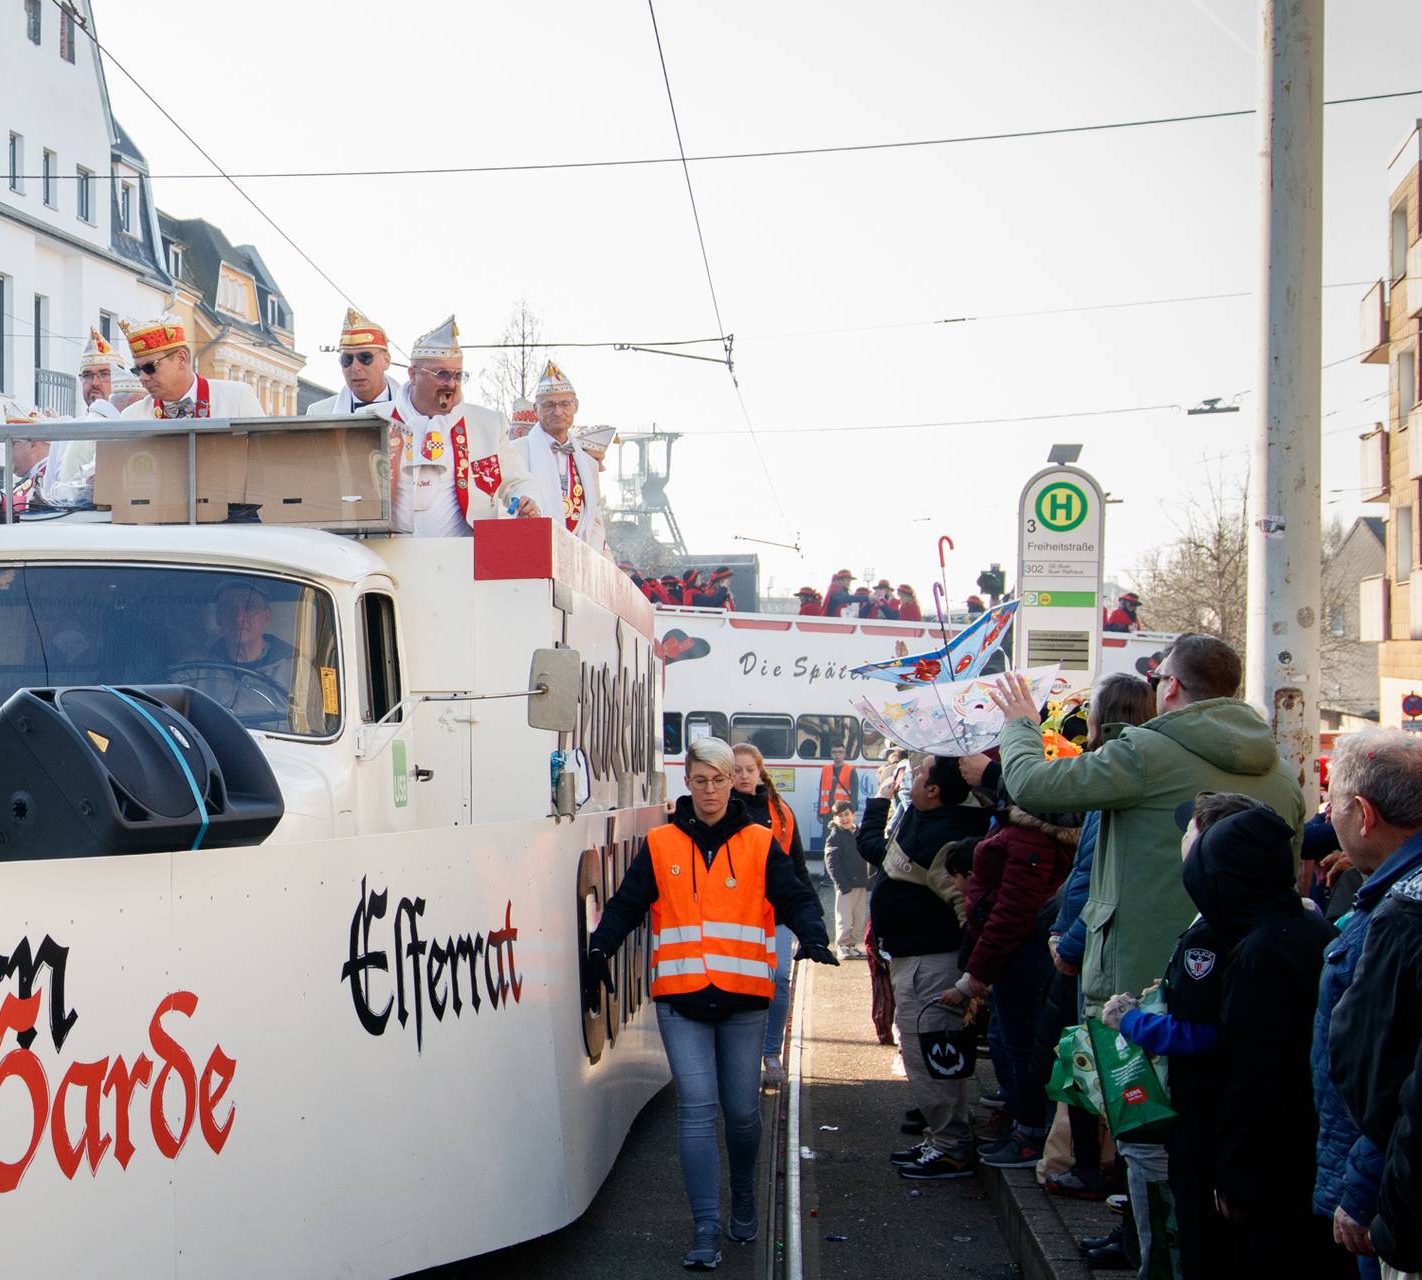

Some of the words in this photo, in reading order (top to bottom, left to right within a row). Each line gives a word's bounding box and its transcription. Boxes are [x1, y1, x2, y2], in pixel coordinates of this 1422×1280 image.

[1050, 494, 1072, 520] H
[1027, 519, 1036, 533] 3
[1027, 541, 1095, 552] Freiheitstraße
[1026, 564, 1044, 574] 302
[739, 651, 782, 676] Die
[341, 874, 523, 1056] Elferrat
